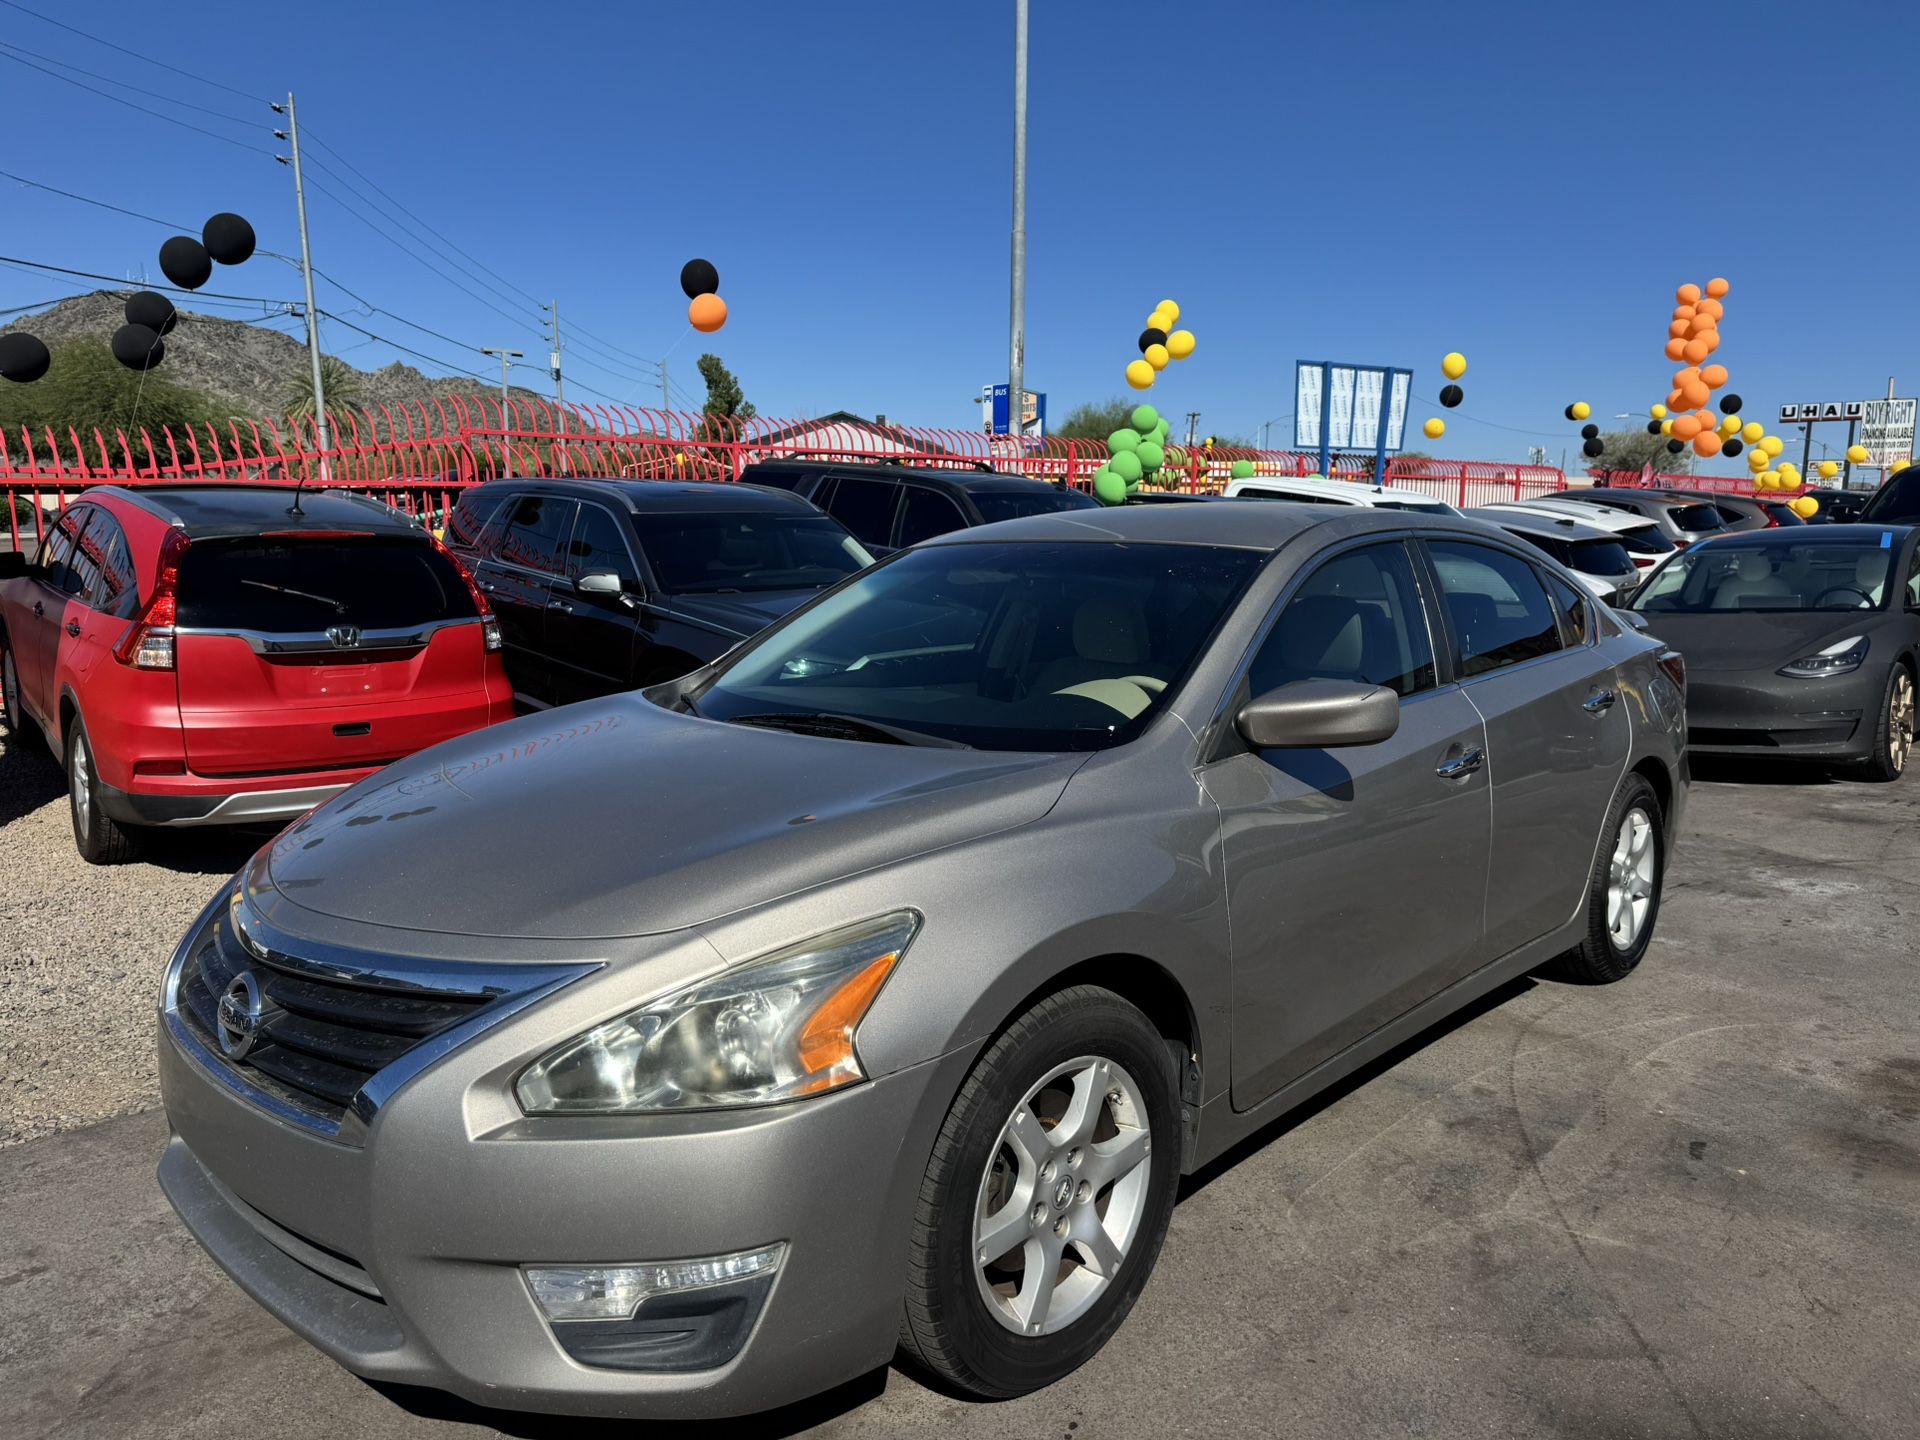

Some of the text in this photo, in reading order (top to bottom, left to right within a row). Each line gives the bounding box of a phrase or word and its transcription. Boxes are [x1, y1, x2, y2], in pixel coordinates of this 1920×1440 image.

[995, 388, 1007, 397] BUS
[1865, 401, 1914, 424] BUY RIGHT
[1861, 426, 1914, 439] FINANCING AVAILABLE
[1878, 452, 1893, 464] CAVE
